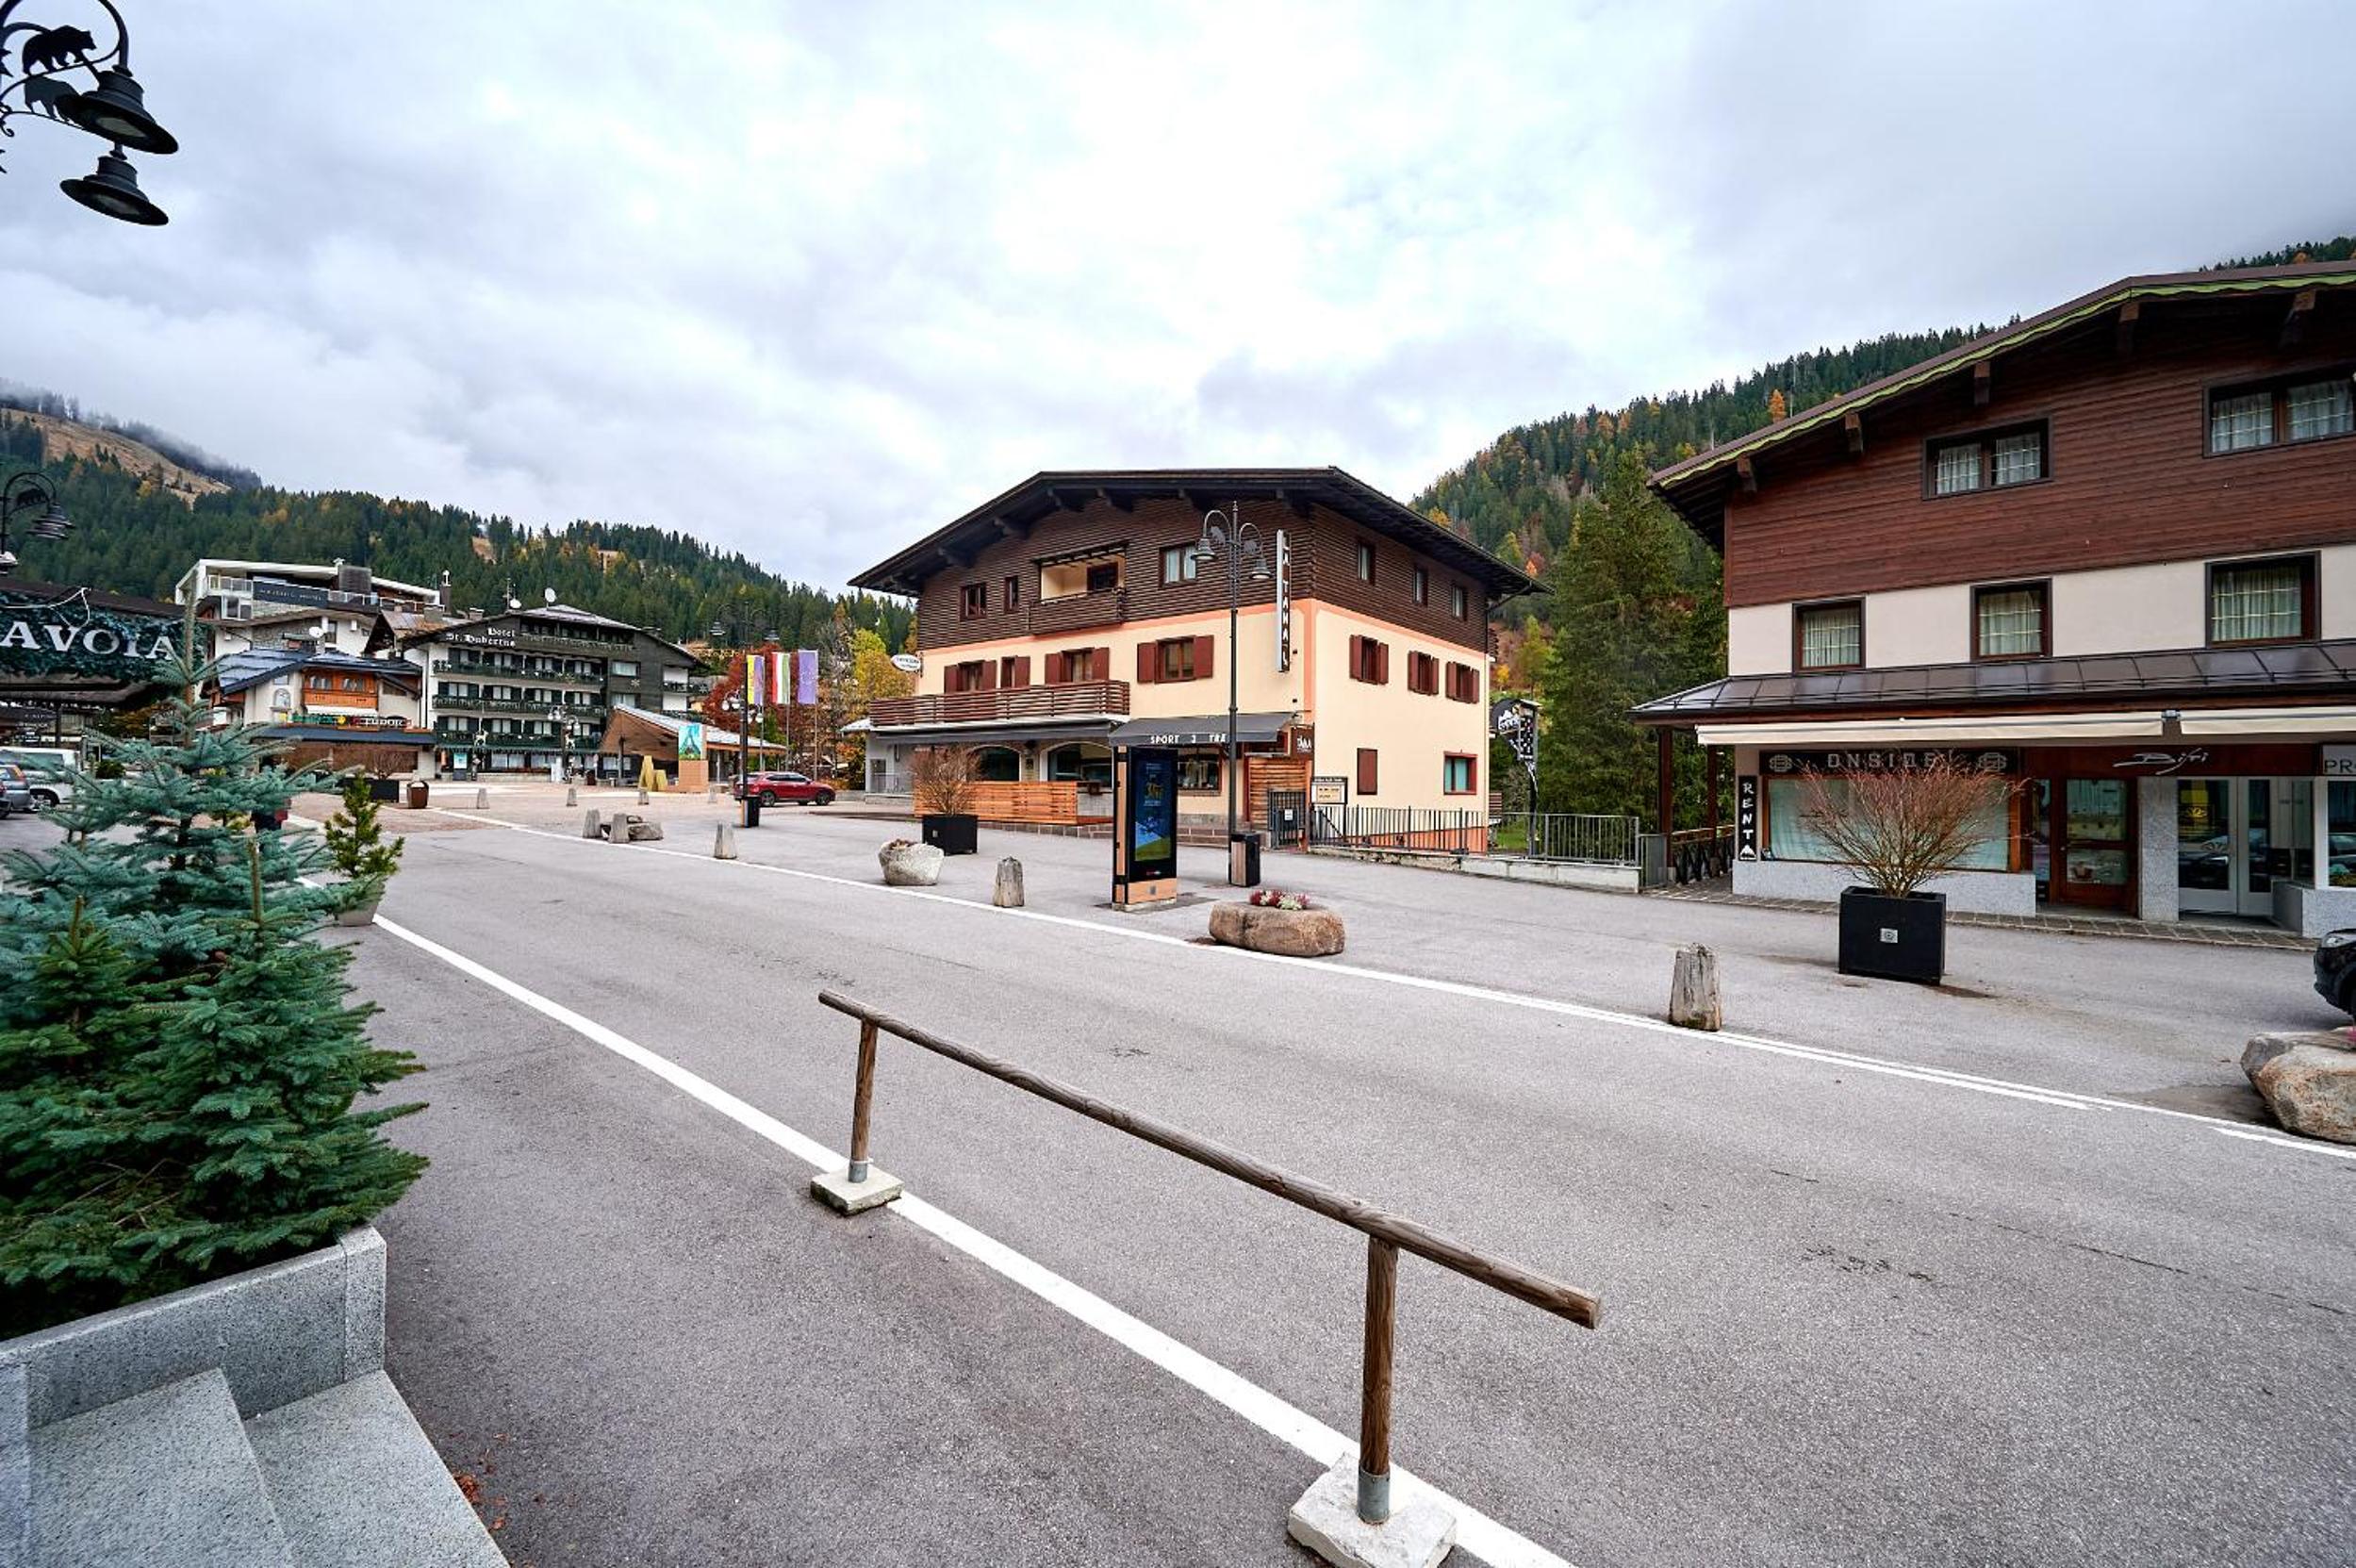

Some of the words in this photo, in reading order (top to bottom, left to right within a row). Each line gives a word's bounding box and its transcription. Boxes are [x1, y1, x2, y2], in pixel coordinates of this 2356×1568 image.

[1150, 734, 1179, 744] SPORT
[1827, 752, 1936, 768] ONSIDE
[2324, 758, 2356, 773] PR
[1741, 782, 1755, 840] RENT
